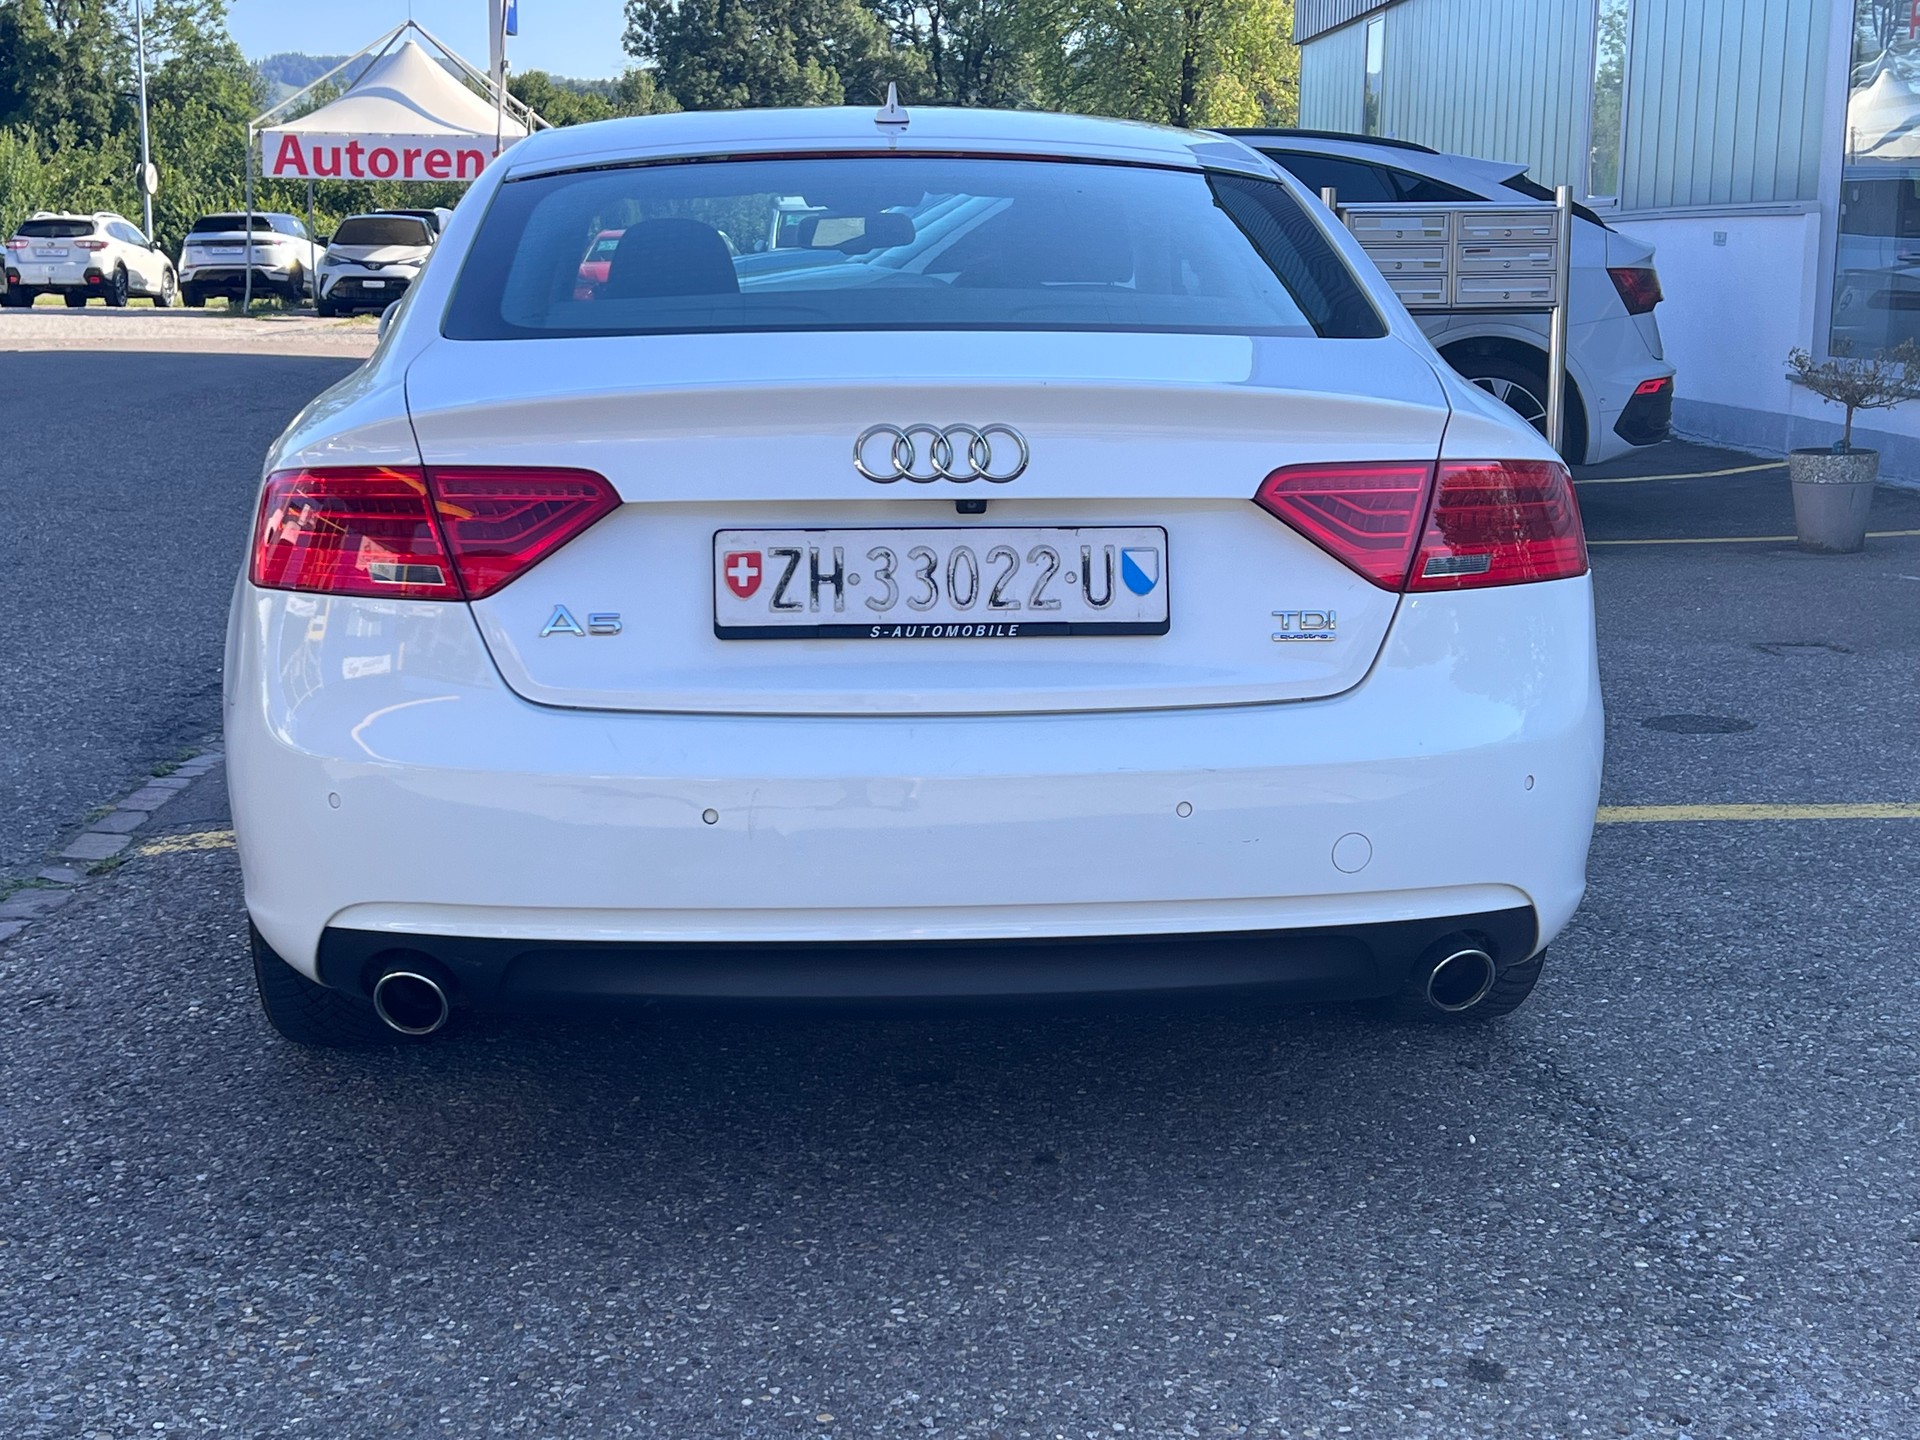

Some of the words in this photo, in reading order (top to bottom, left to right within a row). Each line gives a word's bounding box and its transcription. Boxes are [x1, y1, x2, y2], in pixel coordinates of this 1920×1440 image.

[273, 134, 504, 179] Autoren
[539, 604, 622, 638] A5
[870, 624, 1019, 638] S-AUTOMOBILE
[1271, 610, 1336, 631] TDI
